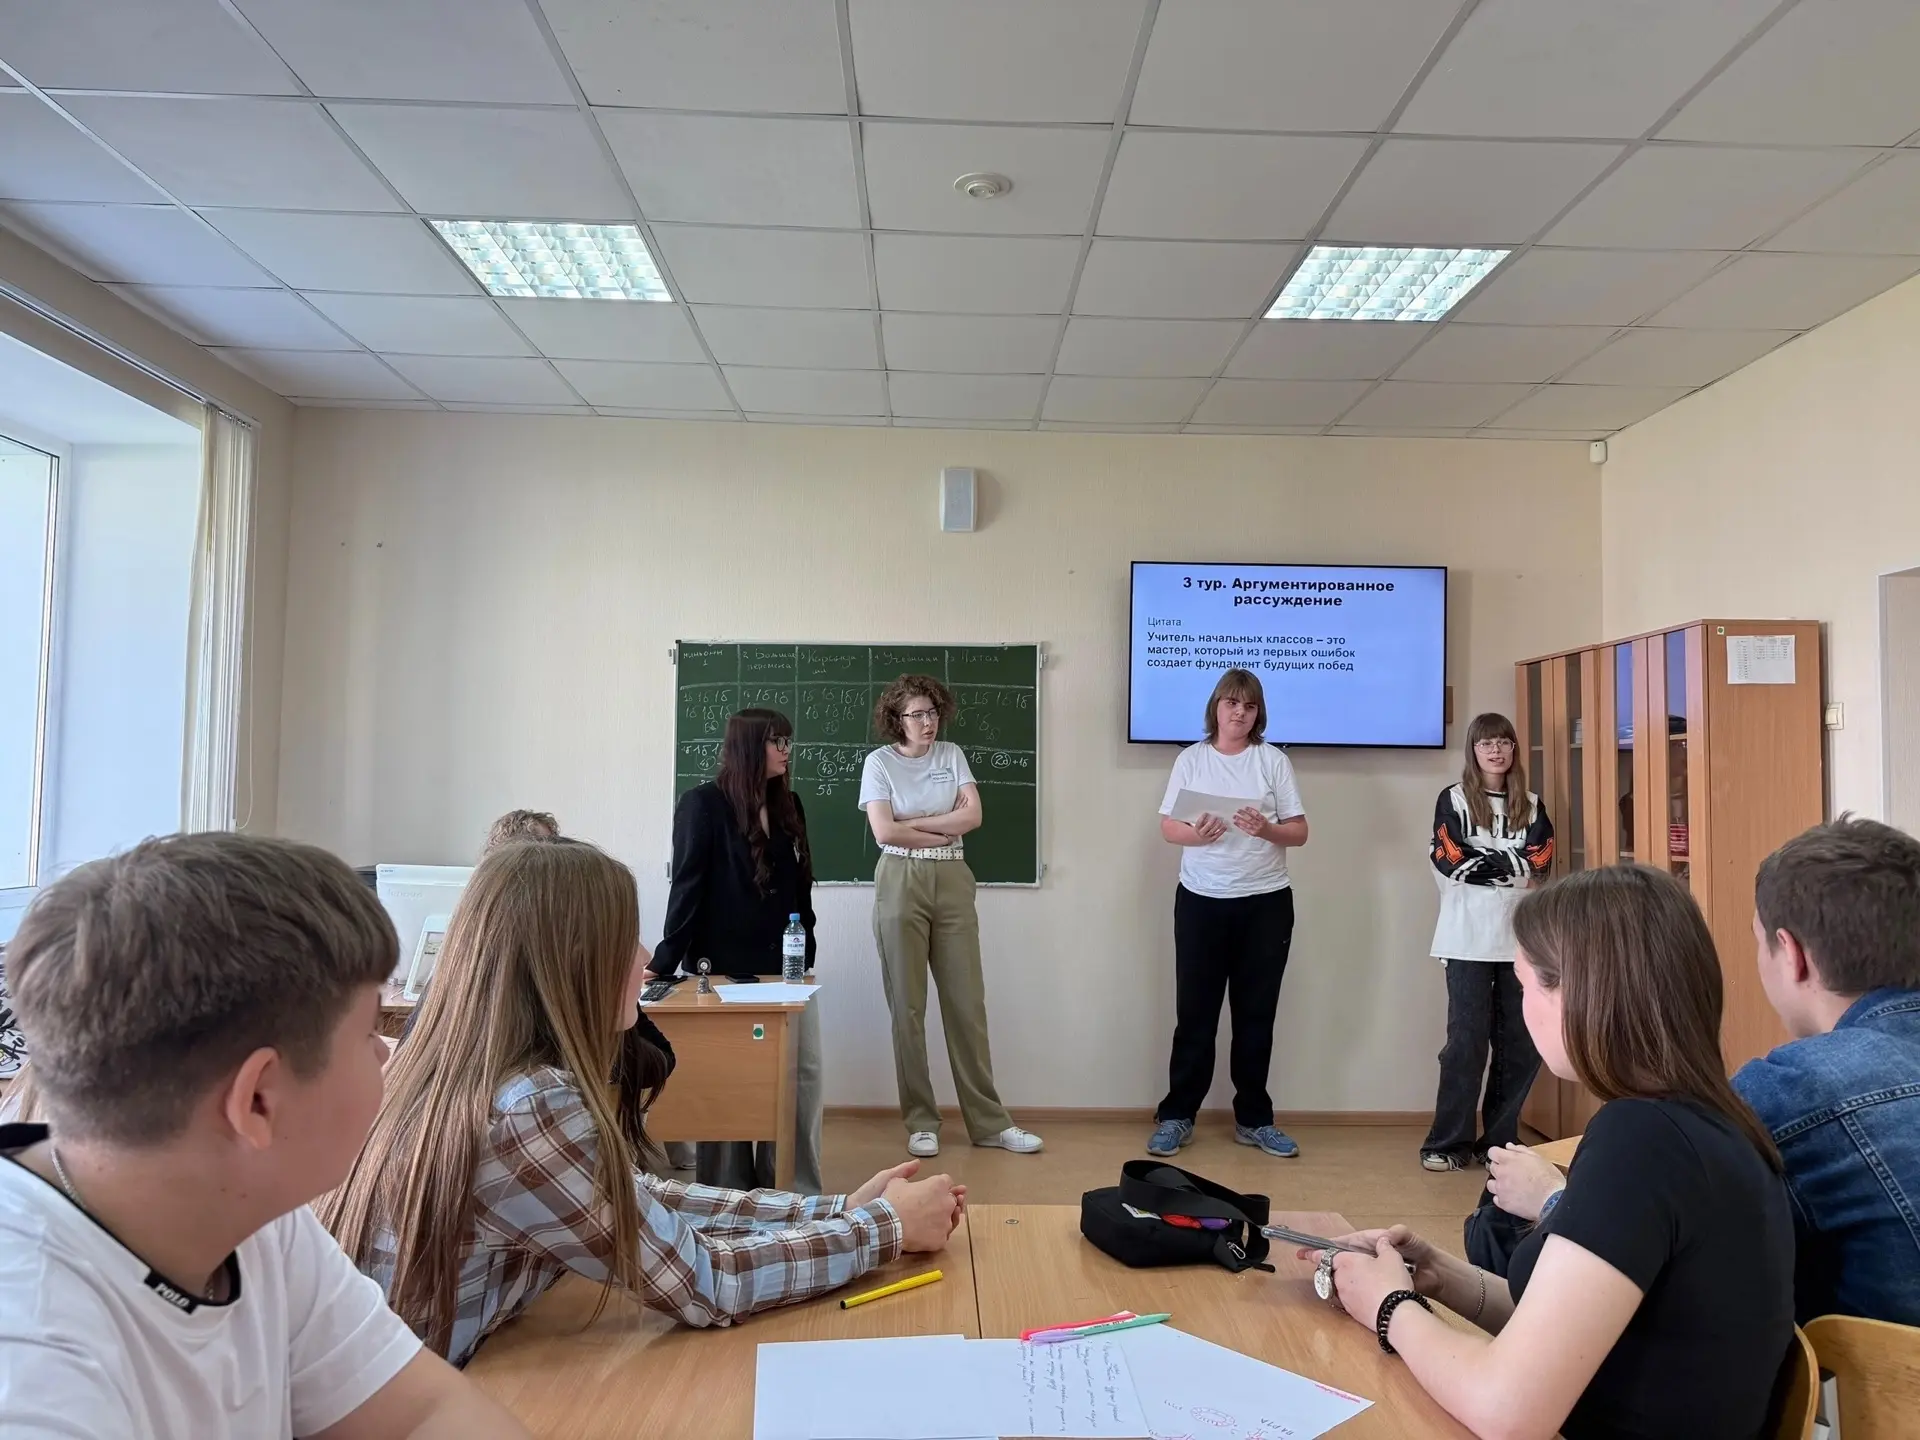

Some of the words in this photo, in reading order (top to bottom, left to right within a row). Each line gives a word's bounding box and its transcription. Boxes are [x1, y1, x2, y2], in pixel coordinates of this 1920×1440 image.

[1182, 577, 1193, 588] 3
[1196, 578, 1227, 591] тур.
[1231, 577, 1395, 593] Аргументированное
[1233, 594, 1343, 608] рассуждение
[1147, 616, 1182, 628] Цитата
[1147, 631, 1195, 643] Учитель
[1198, 634, 1263, 643] начальных
[1266, 635, 1314, 645] классов
[1326, 637, 1346, 645] это
[1147, 646, 1191, 657] мастер,
[1194, 645, 1244, 657] который
[1247, 648, 1260, 656] из
[1263, 649, 1308, 659] первых
[1311, 647, 1356, 658] ошибок
[1147, 659, 1192, 669] создает
[1195, 658, 1261, 670] фундамент
[1263, 659, 1315, 672] будущих
[1318, 660, 1354, 672] побед
[154, 1281, 191, 1308] POLO
